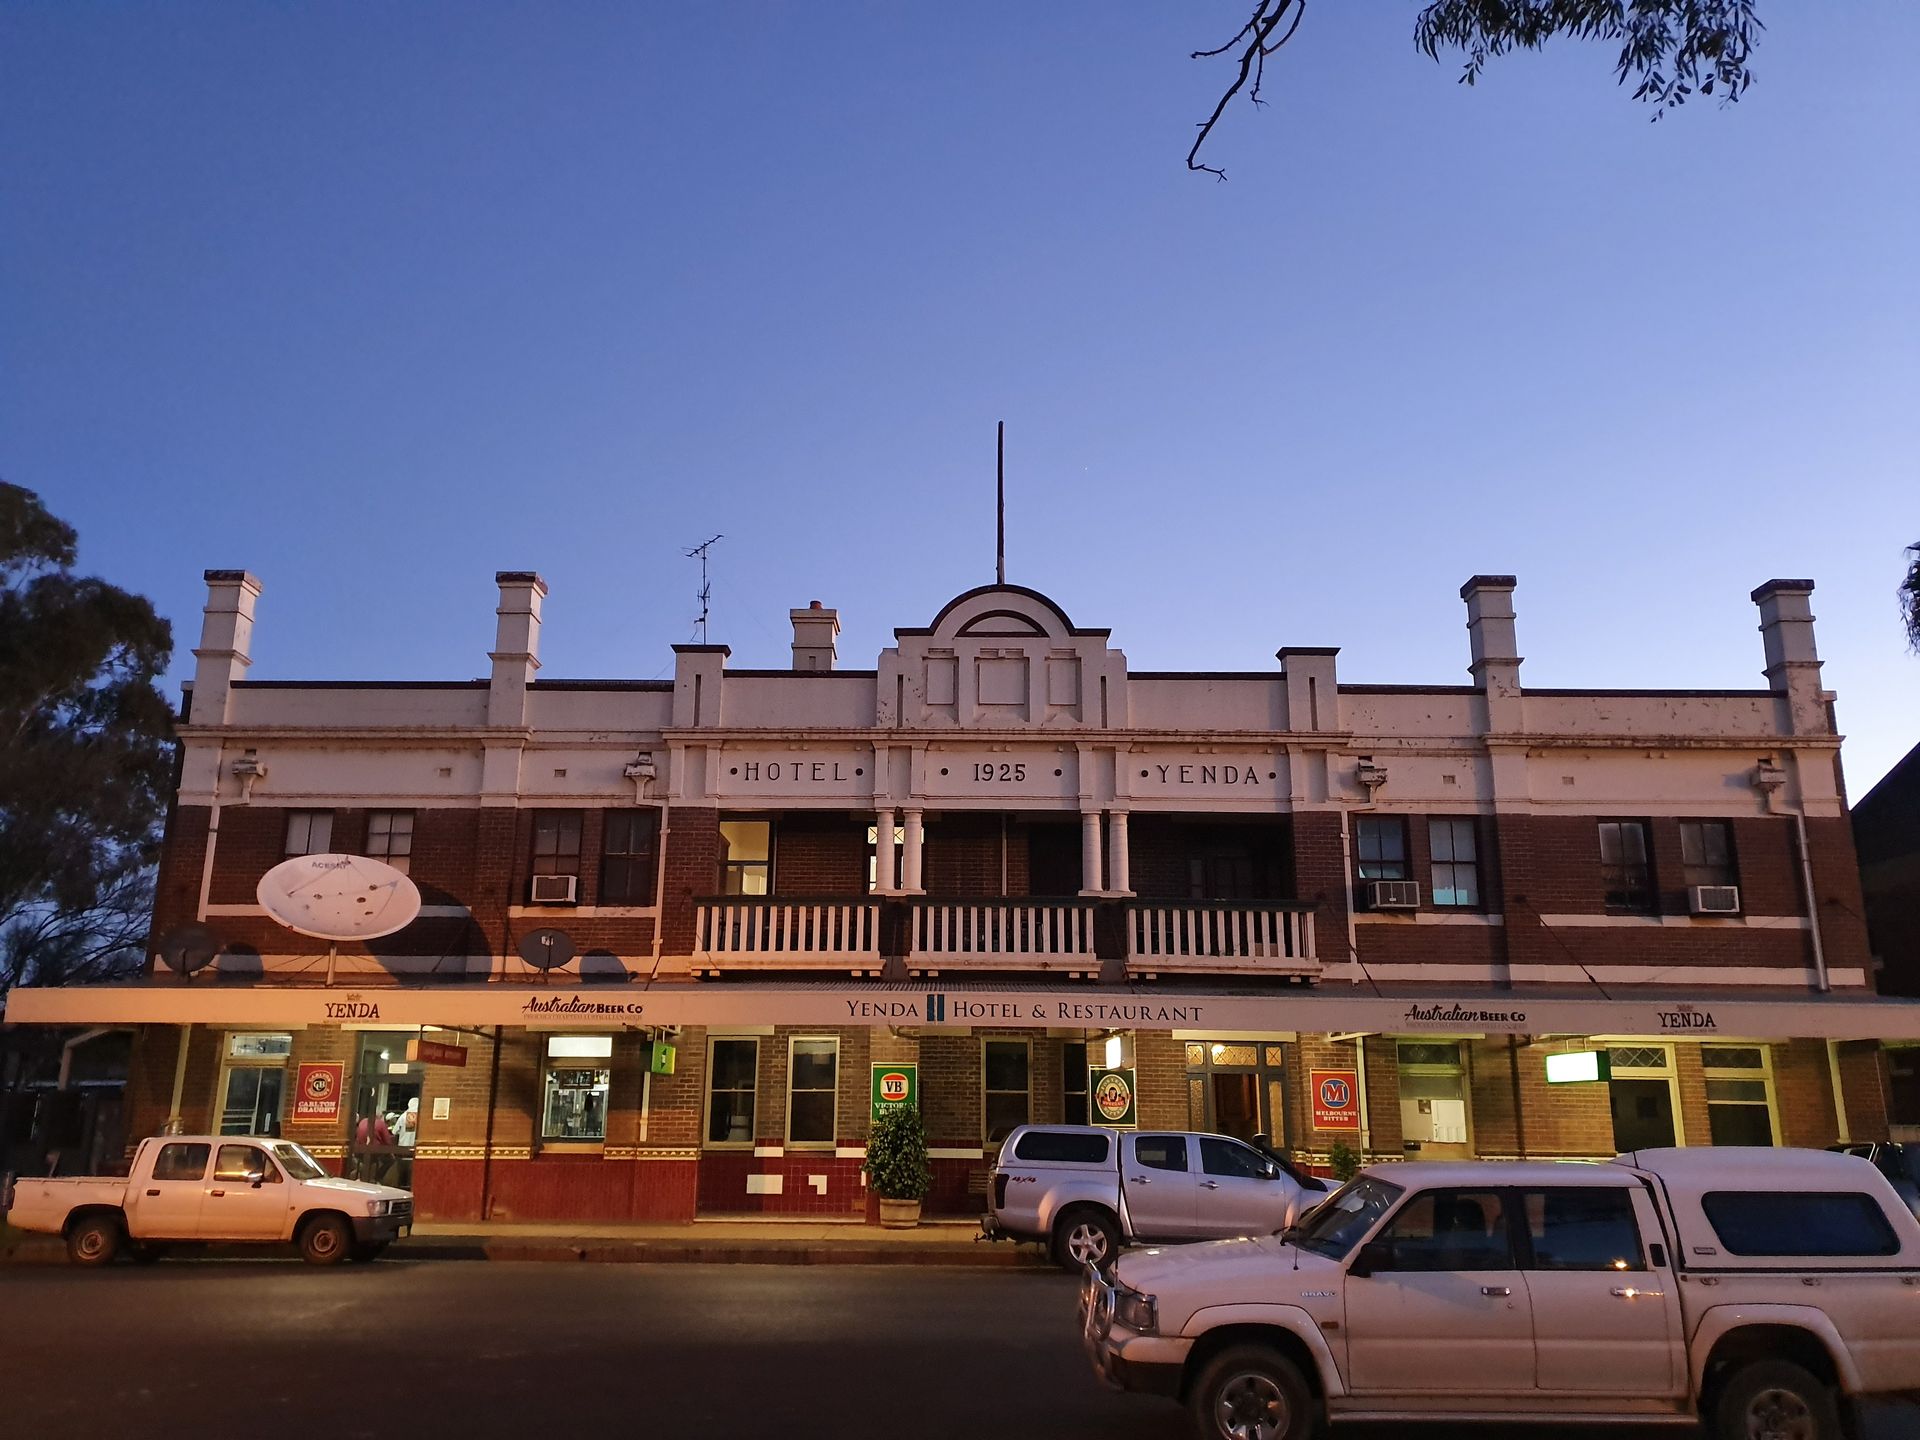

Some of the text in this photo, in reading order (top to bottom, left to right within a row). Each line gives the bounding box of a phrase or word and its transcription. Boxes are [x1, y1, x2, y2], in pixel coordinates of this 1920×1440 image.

[745, 762, 848, 781] HOTEL
[973, 763, 1027, 782] 1925
[1156, 764, 1260, 785] YENDA
[324, 1002, 380, 1018] YENDA
[522, 995, 643, 1014] Australian BEER Co
[846, 1000, 1203, 1022] YENDA HOTEL & RESTAURANT
[1404, 1003, 1526, 1022] Australian BEER Co
[1657, 1011, 1717, 1028] YENDA
[885, 1081, 903, 1093] VB
[1323, 1083, 1347, 1103] M
